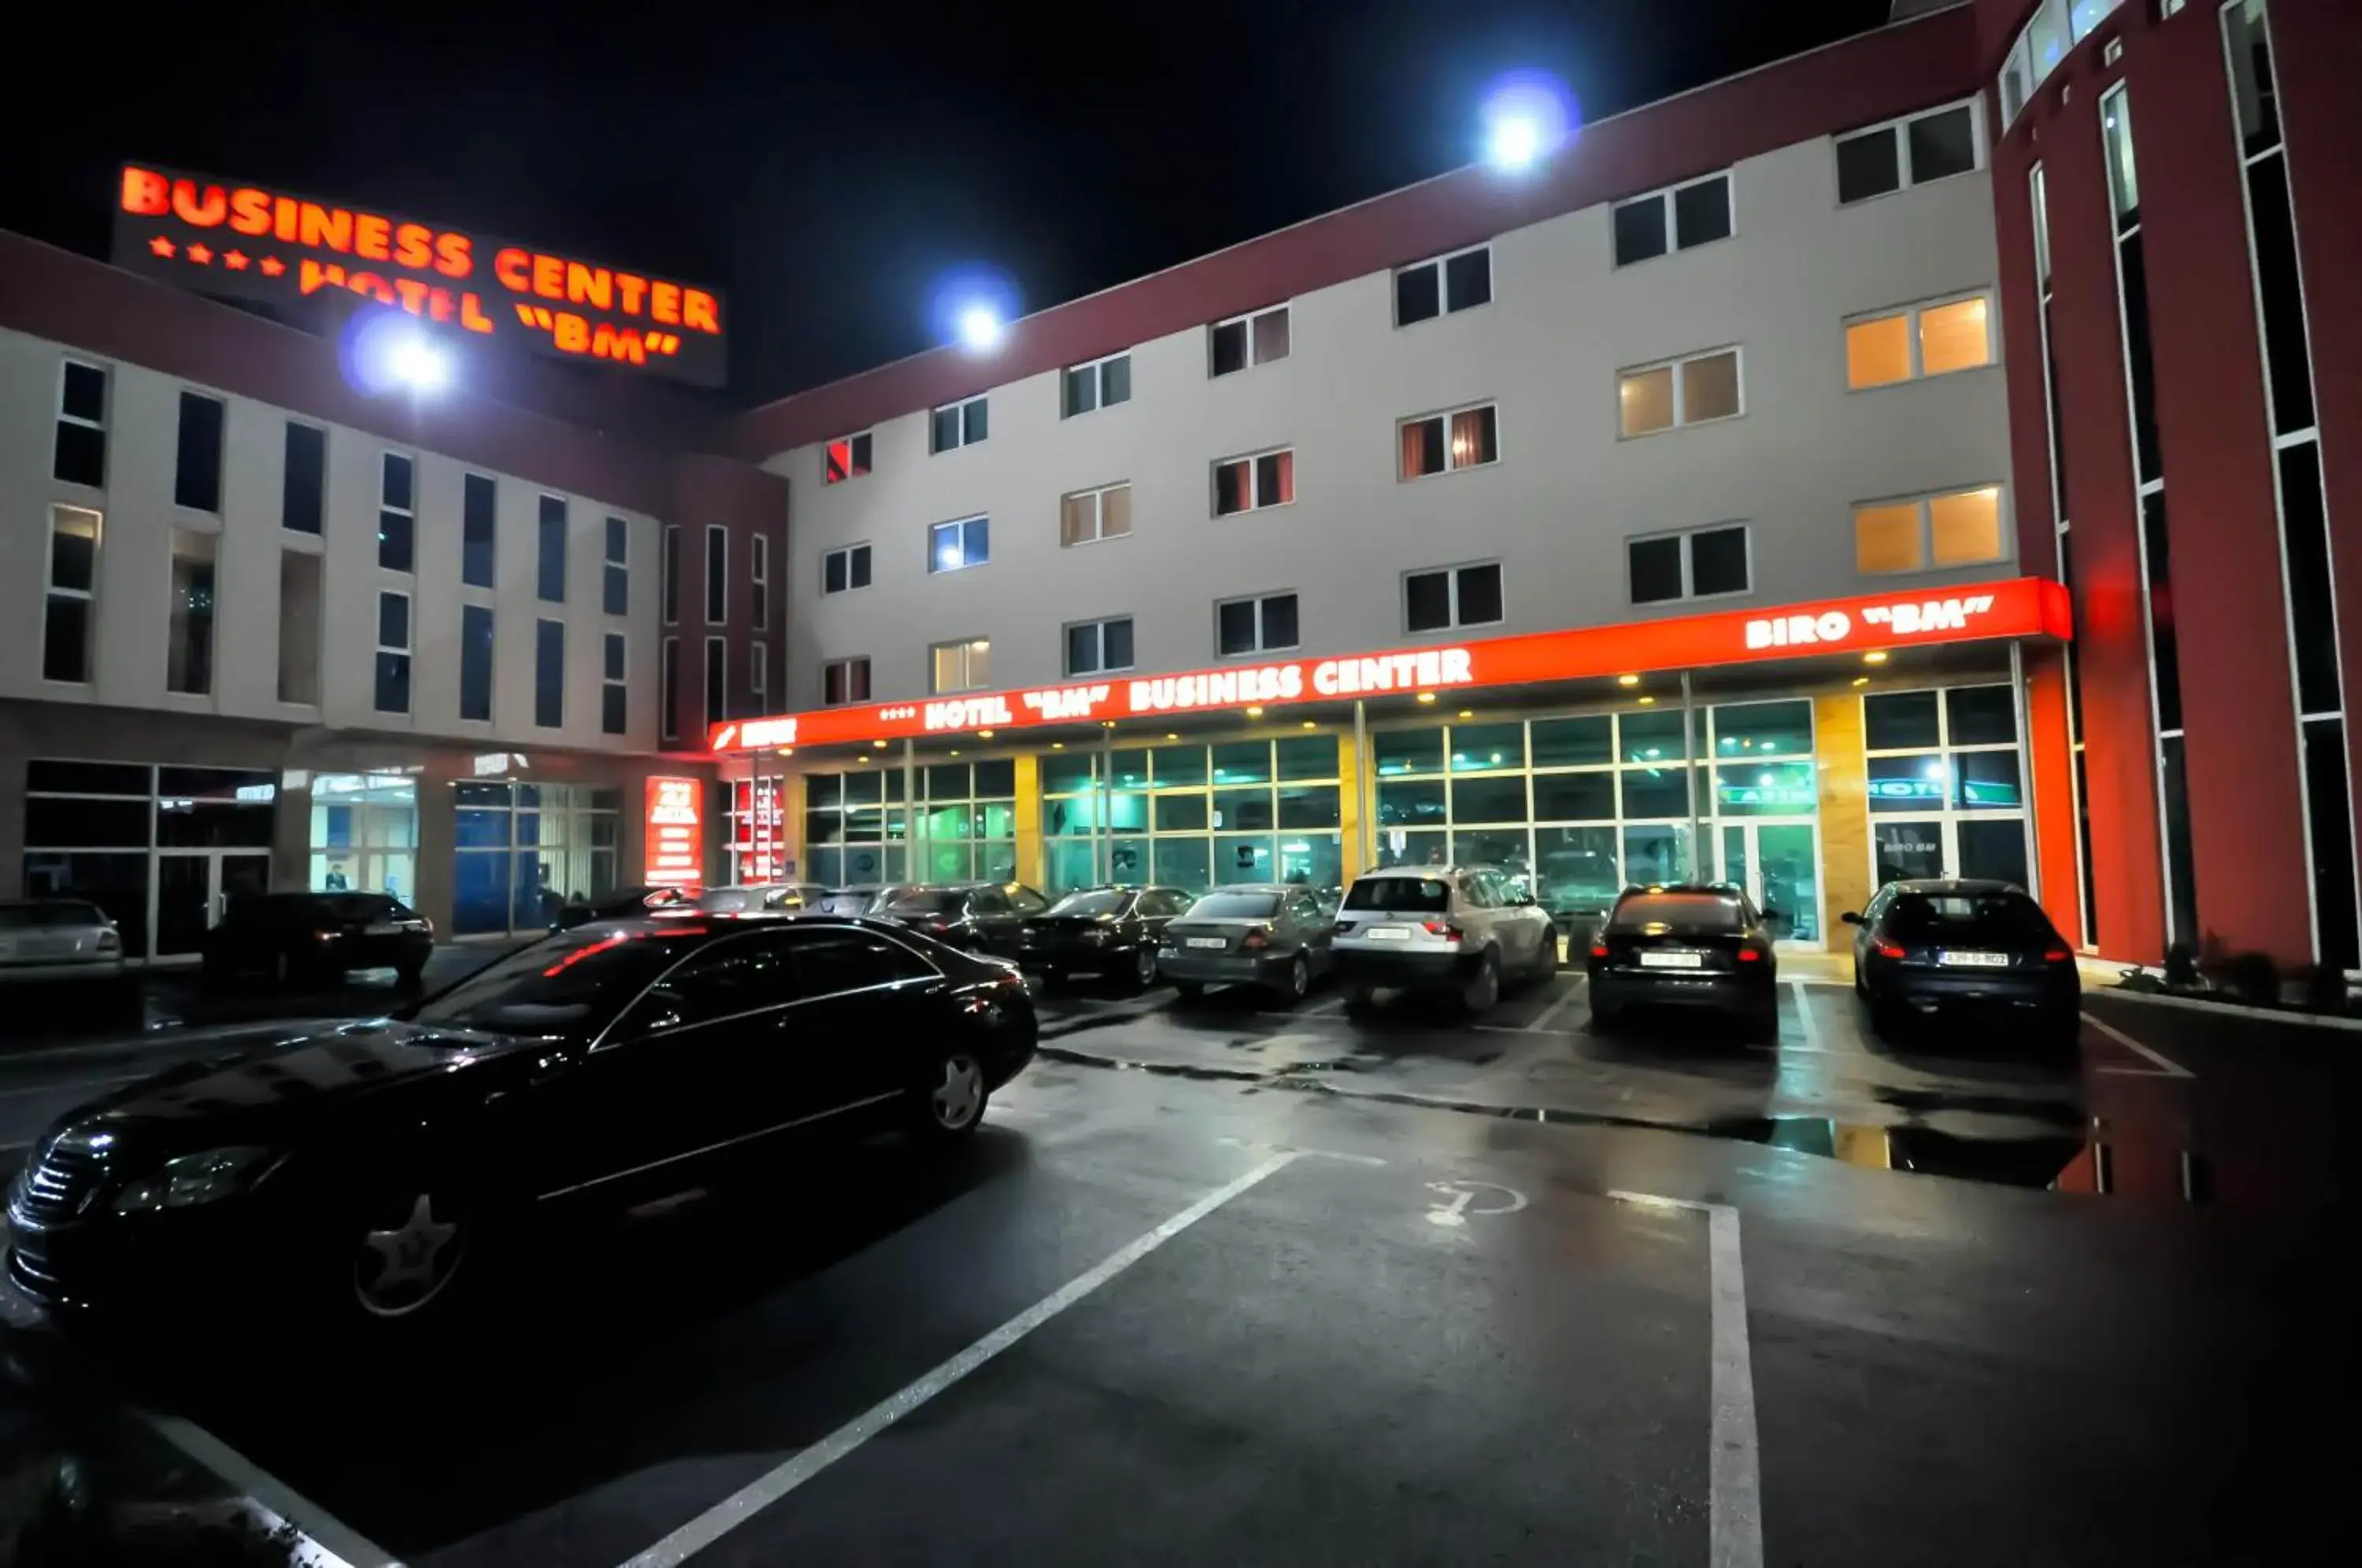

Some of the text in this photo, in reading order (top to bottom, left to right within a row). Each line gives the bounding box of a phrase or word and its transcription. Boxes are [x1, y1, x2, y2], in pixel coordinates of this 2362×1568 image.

[120, 167, 720, 335] BUSINESS CENTER
[1745, 611, 1851, 649] BIRO
[924, 695, 1013, 731] HOTEL
[1128, 664, 1304, 712] BUSINESS
[1312, 648, 1473, 696] CENTER
